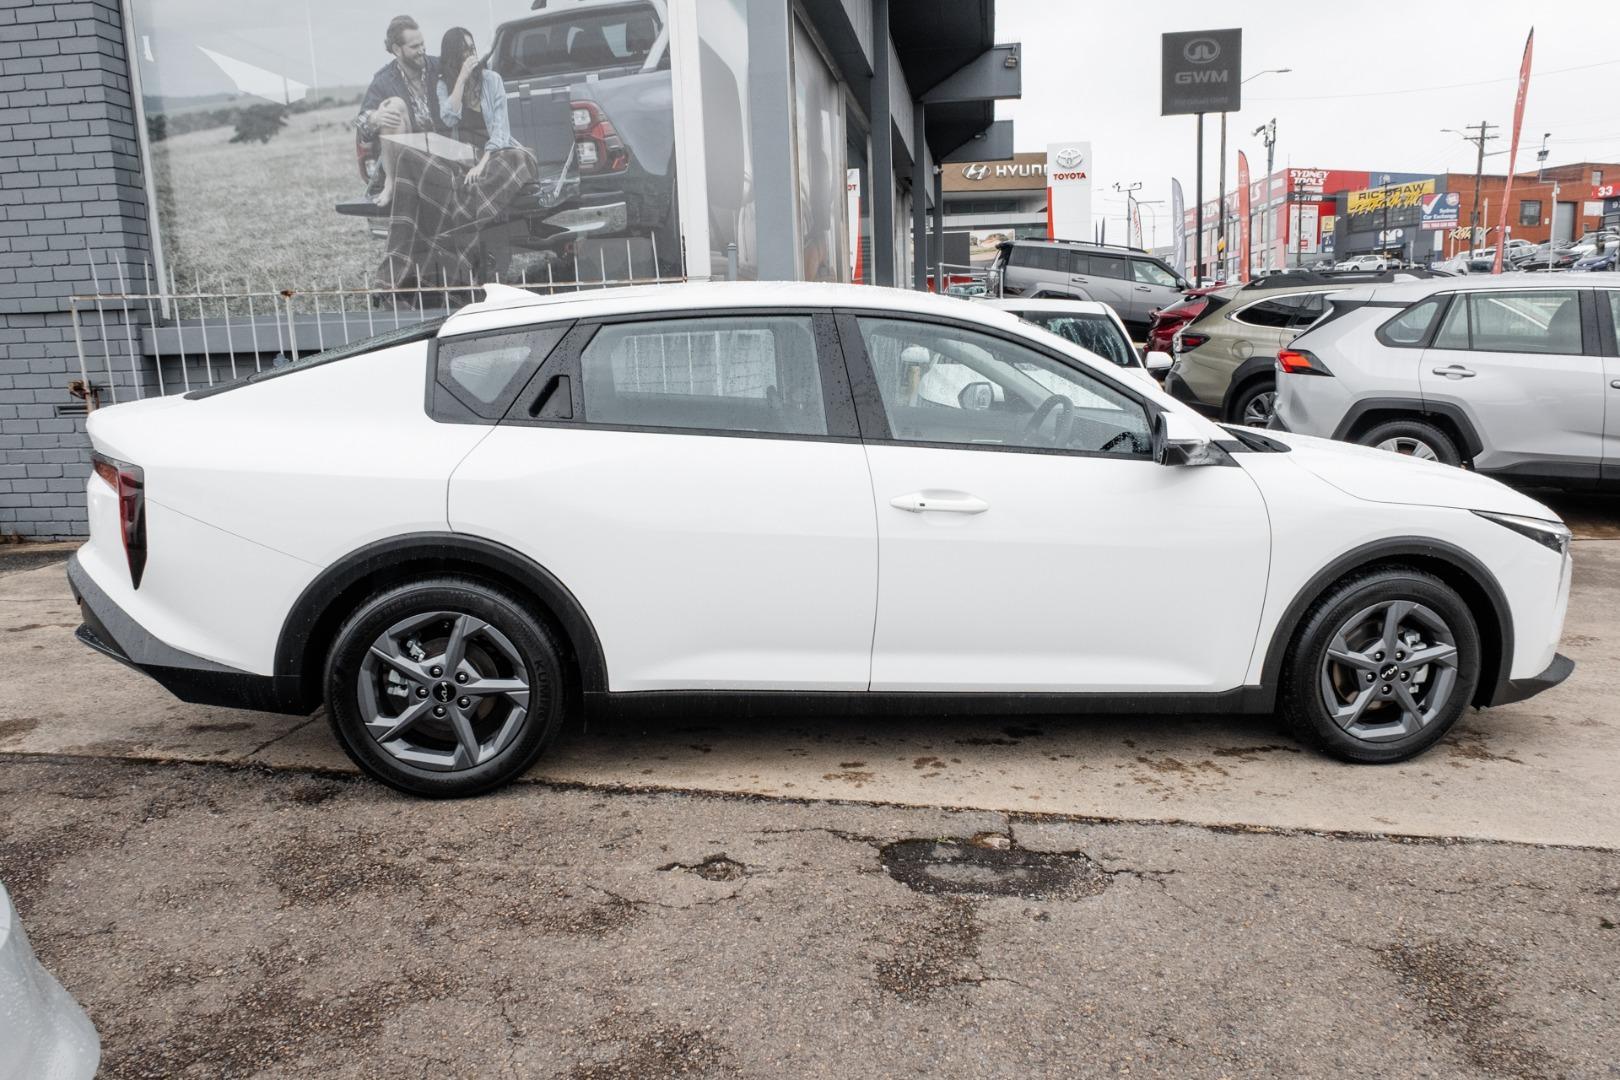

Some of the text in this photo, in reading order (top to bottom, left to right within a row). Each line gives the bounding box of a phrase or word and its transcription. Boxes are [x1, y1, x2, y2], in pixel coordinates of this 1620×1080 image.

[1175, 69, 1228, 84] GWM
[1053, 172, 1087, 181] TOYOTA
[1289, 170, 1330, 178] SYDNEY
[1598, 186, 1613, 196] 33
